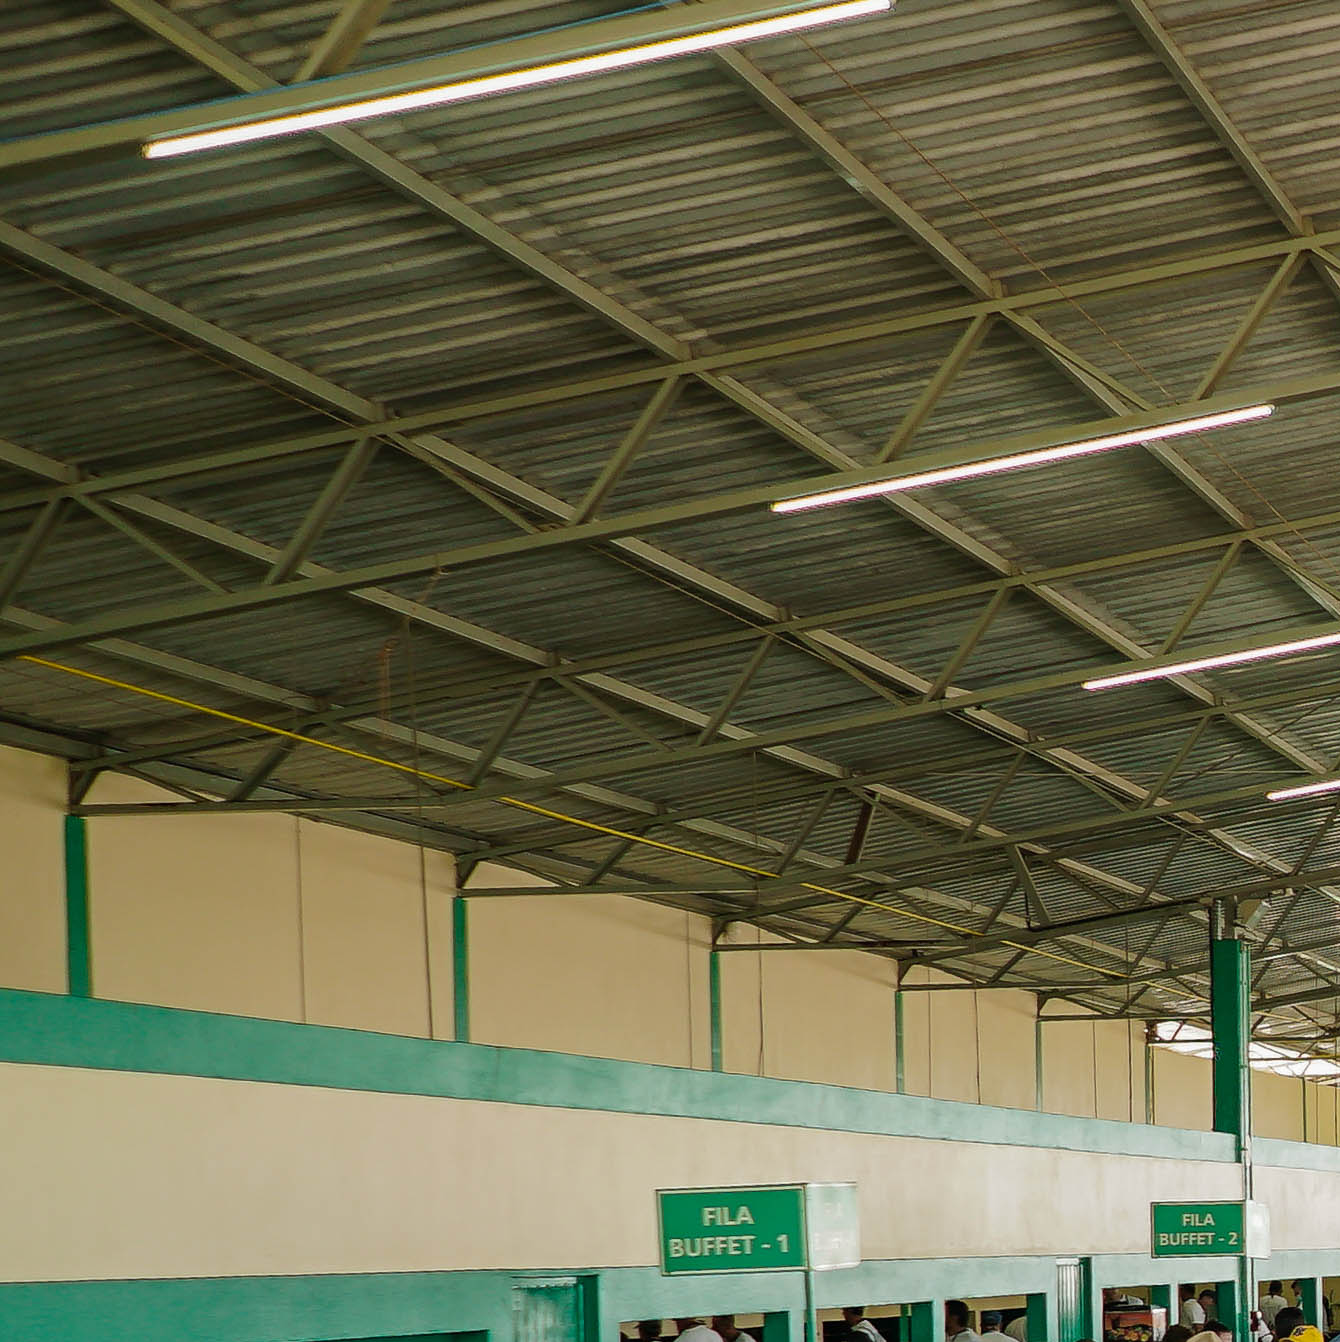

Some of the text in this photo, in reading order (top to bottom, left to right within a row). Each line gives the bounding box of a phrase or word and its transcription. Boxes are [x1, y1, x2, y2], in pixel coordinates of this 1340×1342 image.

[702, 1206, 755, 1226] FILA
[1182, 1213, 1215, 1227] FILA
[669, 1235, 756, 1257] BUFFET
[776, 1234, 789, 1252] 1
[1160, 1232, 1215, 1246] BUFFET
[1228, 1232, 1238, 1245] 2
